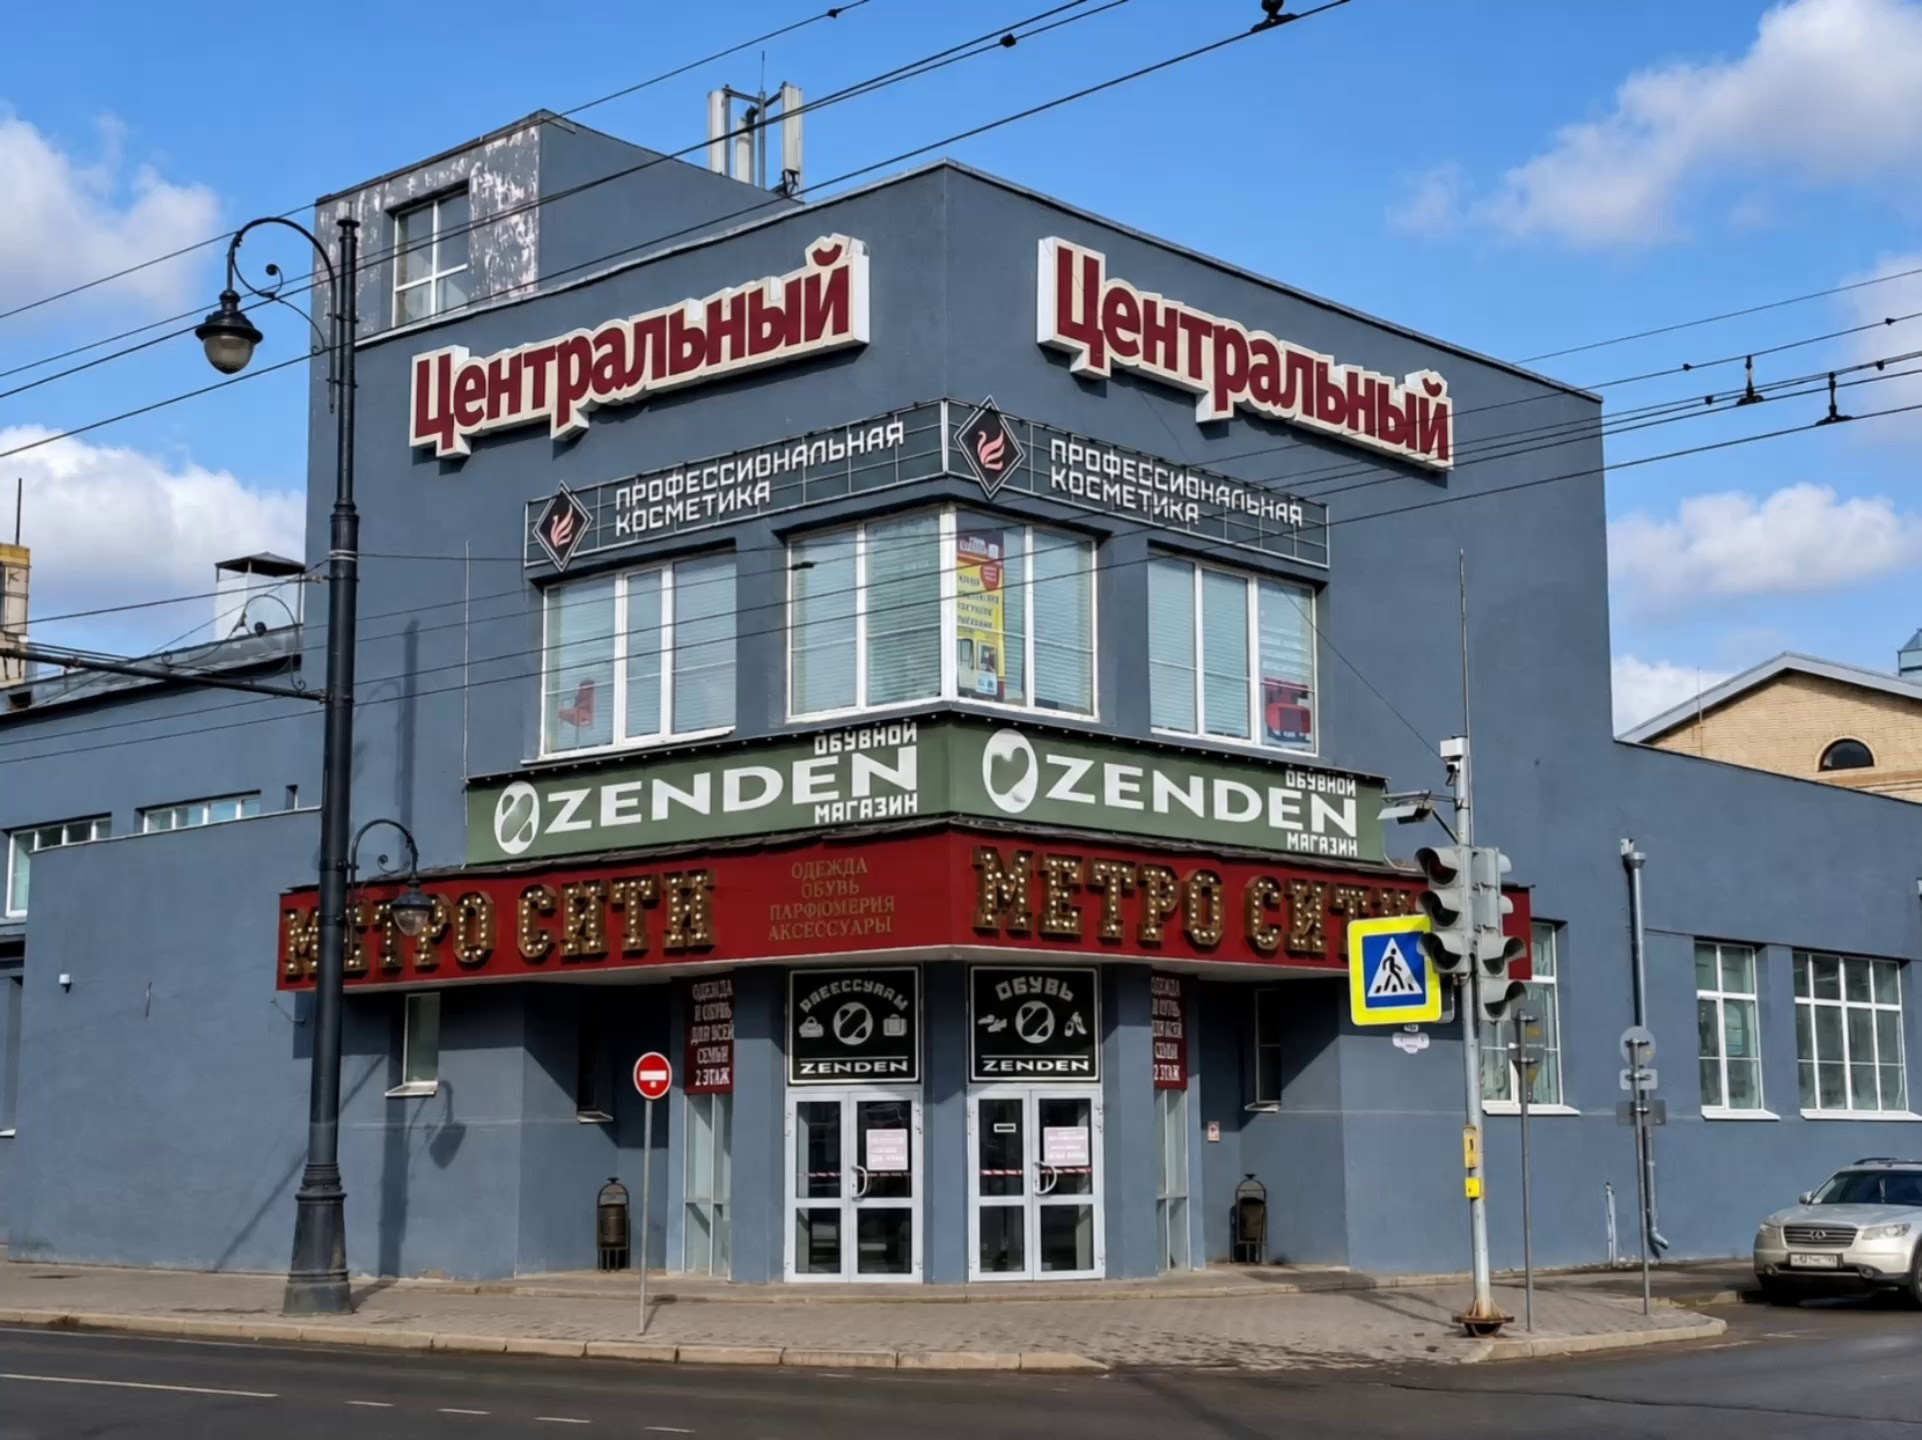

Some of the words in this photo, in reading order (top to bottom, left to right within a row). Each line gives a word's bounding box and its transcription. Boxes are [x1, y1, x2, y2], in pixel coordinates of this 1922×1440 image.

[412, 240, 852, 453] Центральный
[1055, 244, 1451, 463] Центральный
[615, 420, 904, 510] ПРОФЕССИОНАЛЬНАЯ
[1050, 437, 1303, 527] ПРОФЕССИОНАЛЬНАЯ
[615, 481, 771, 537] КОСМЕТИКА
[1050, 465, 1199, 525] КОСМЕТИКА
[814, 718, 917, 756] ОБУВНОЙ
[543, 745, 918, 834] ZENDEN
[1045, 753, 1357, 838] ZENDEN
[1285, 769, 1357, 798] ОБУВНОЙ
[814, 792, 918, 825] МАГАЗИН
[1286, 831, 1358, 858] МАГАЗИН
[791, 857, 868, 881] ОДЕЖДА
[769, 896, 895, 920] ПАРФЮМЕРИЯ
[801, 880, 860, 899] ОБУВЬ
[972, 844, 1226, 948] МЕТРО
[516, 869, 717, 960] СИТИ
[768, 916, 893, 941] АКСЕССУАРЫ
[995, 976, 1074, 1002] ОБУВЬ
[800, 1060, 908, 1075] ZENDEN
[982, 1060, 1089, 1072] ZENDEN
